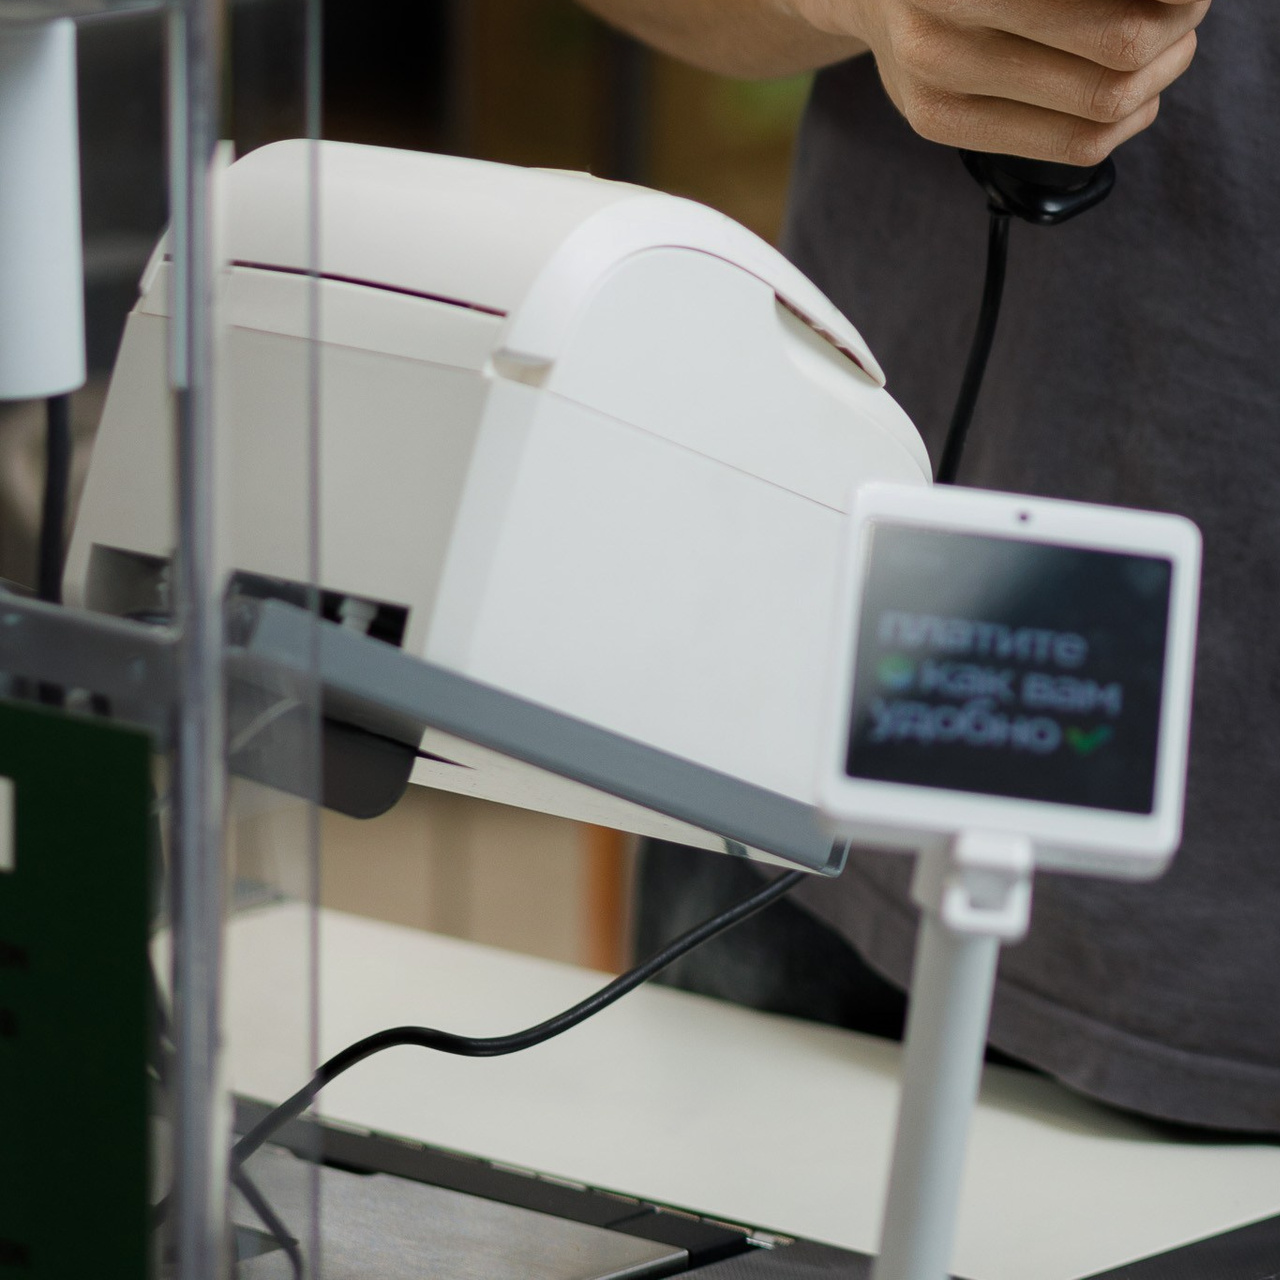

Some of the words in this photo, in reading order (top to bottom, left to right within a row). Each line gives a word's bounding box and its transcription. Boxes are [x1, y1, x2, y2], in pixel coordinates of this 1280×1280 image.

[920, 659, 1015, 700] как
[1022, 673, 1122, 717] вам
[872, 697, 1061, 753] удобно
